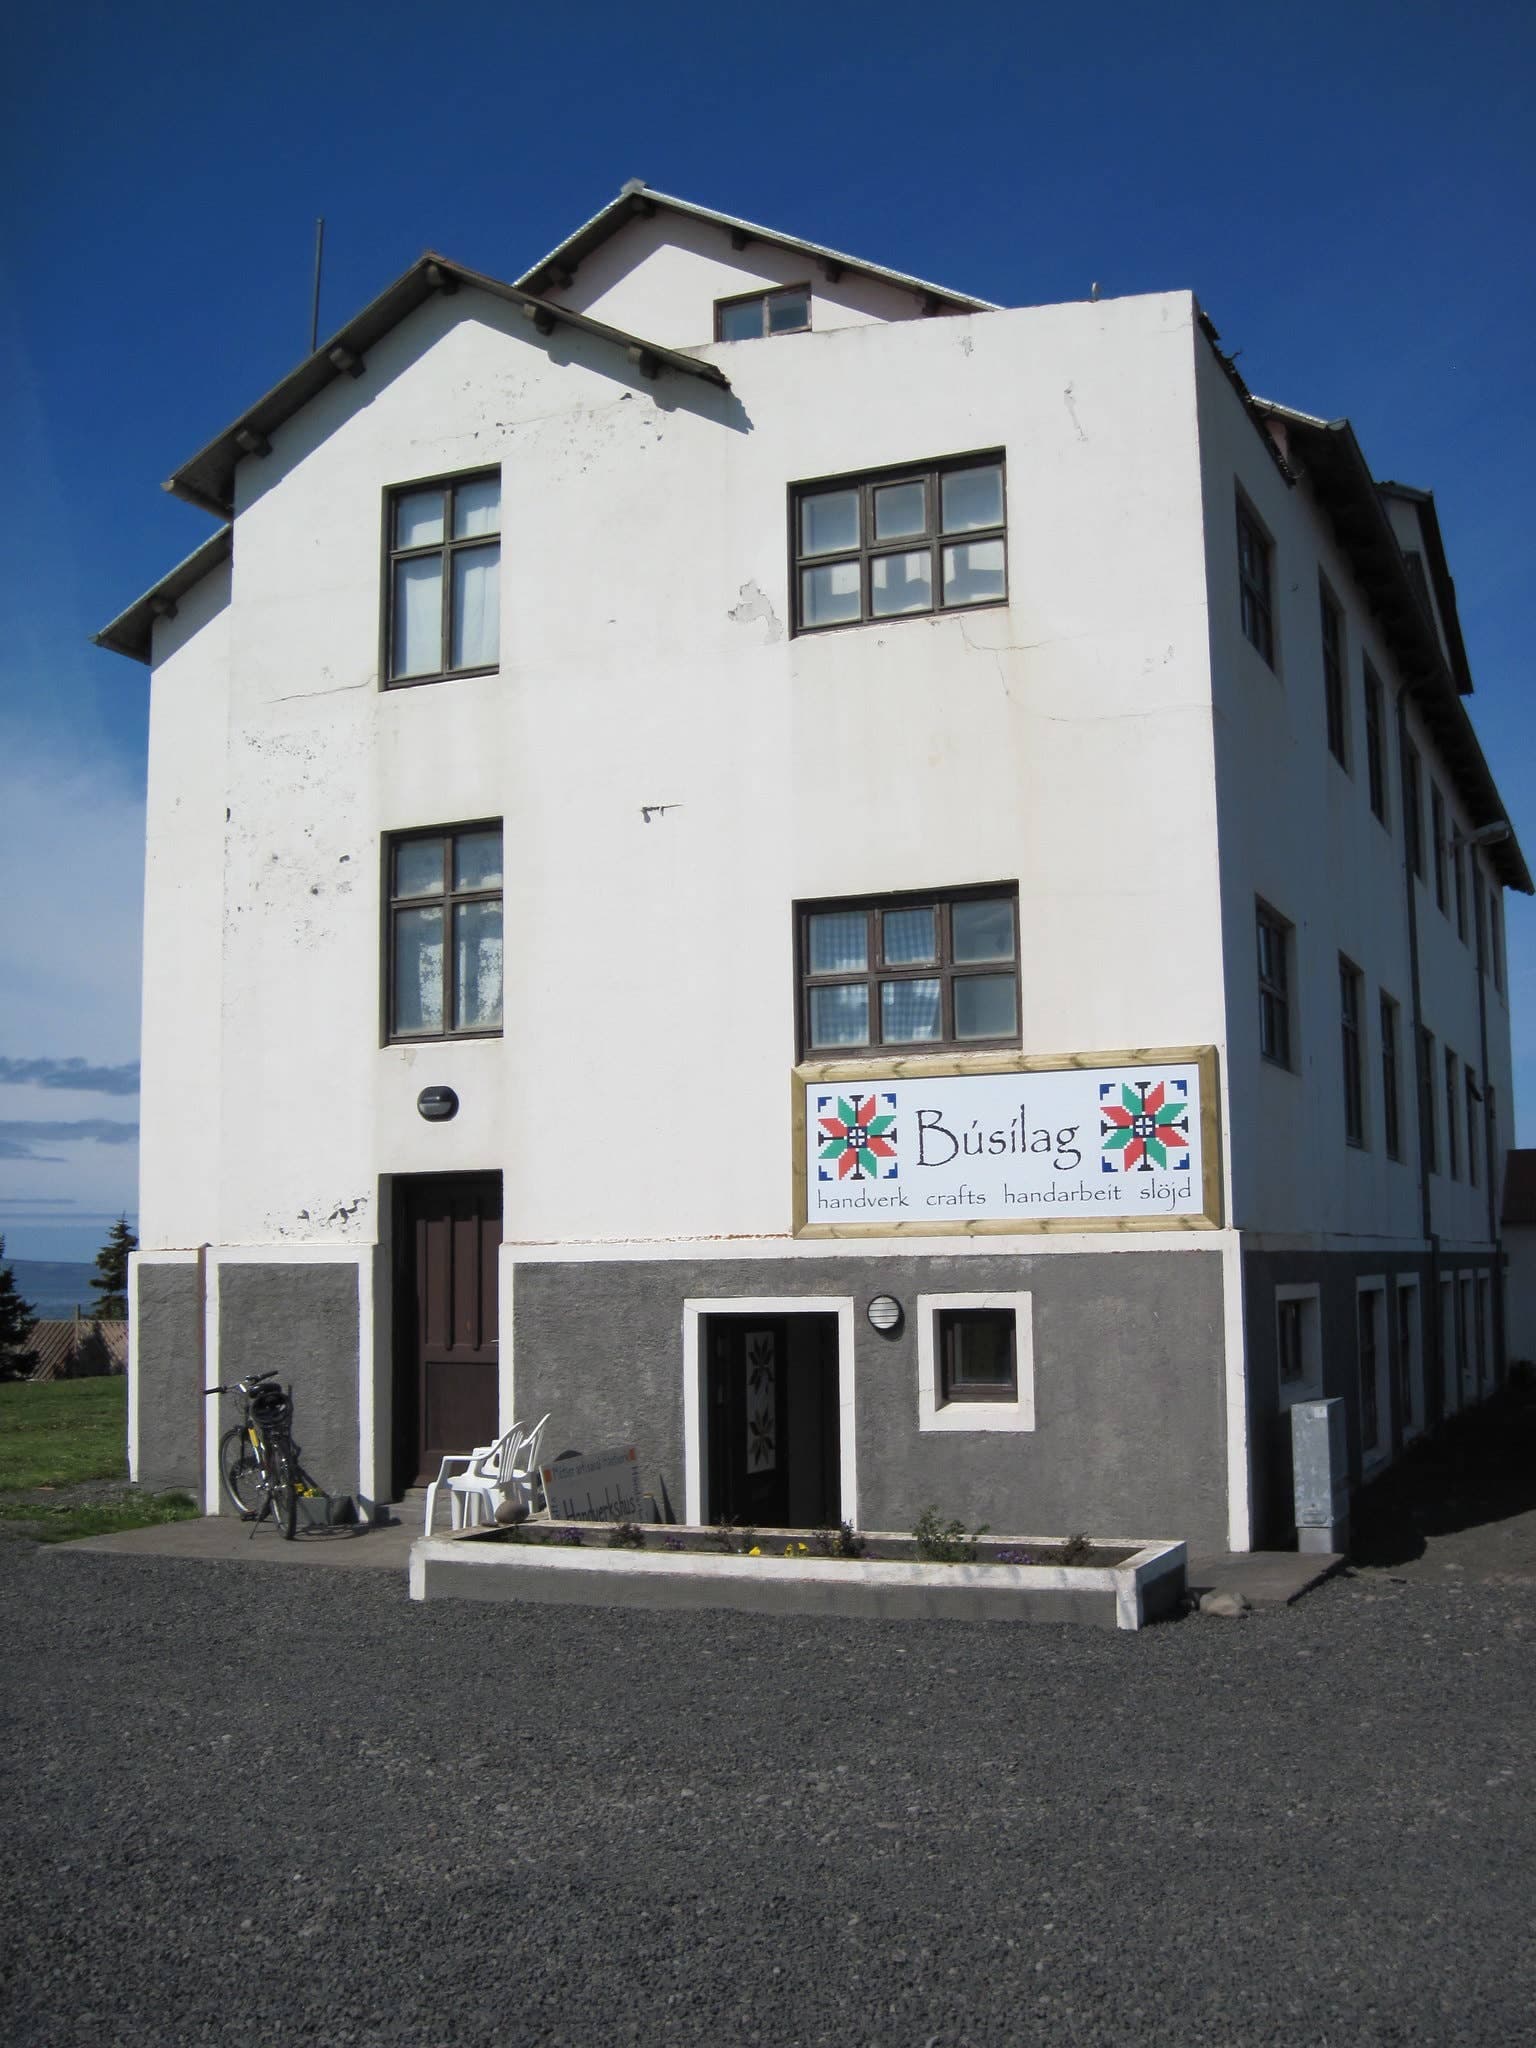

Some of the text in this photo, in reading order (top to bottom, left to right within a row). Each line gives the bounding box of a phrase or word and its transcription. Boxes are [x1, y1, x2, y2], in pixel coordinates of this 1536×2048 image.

[915, 1103, 1082, 1171] Búsílag
[817, 1177, 1192, 1212] handverk crafts handarbeit slöjd
